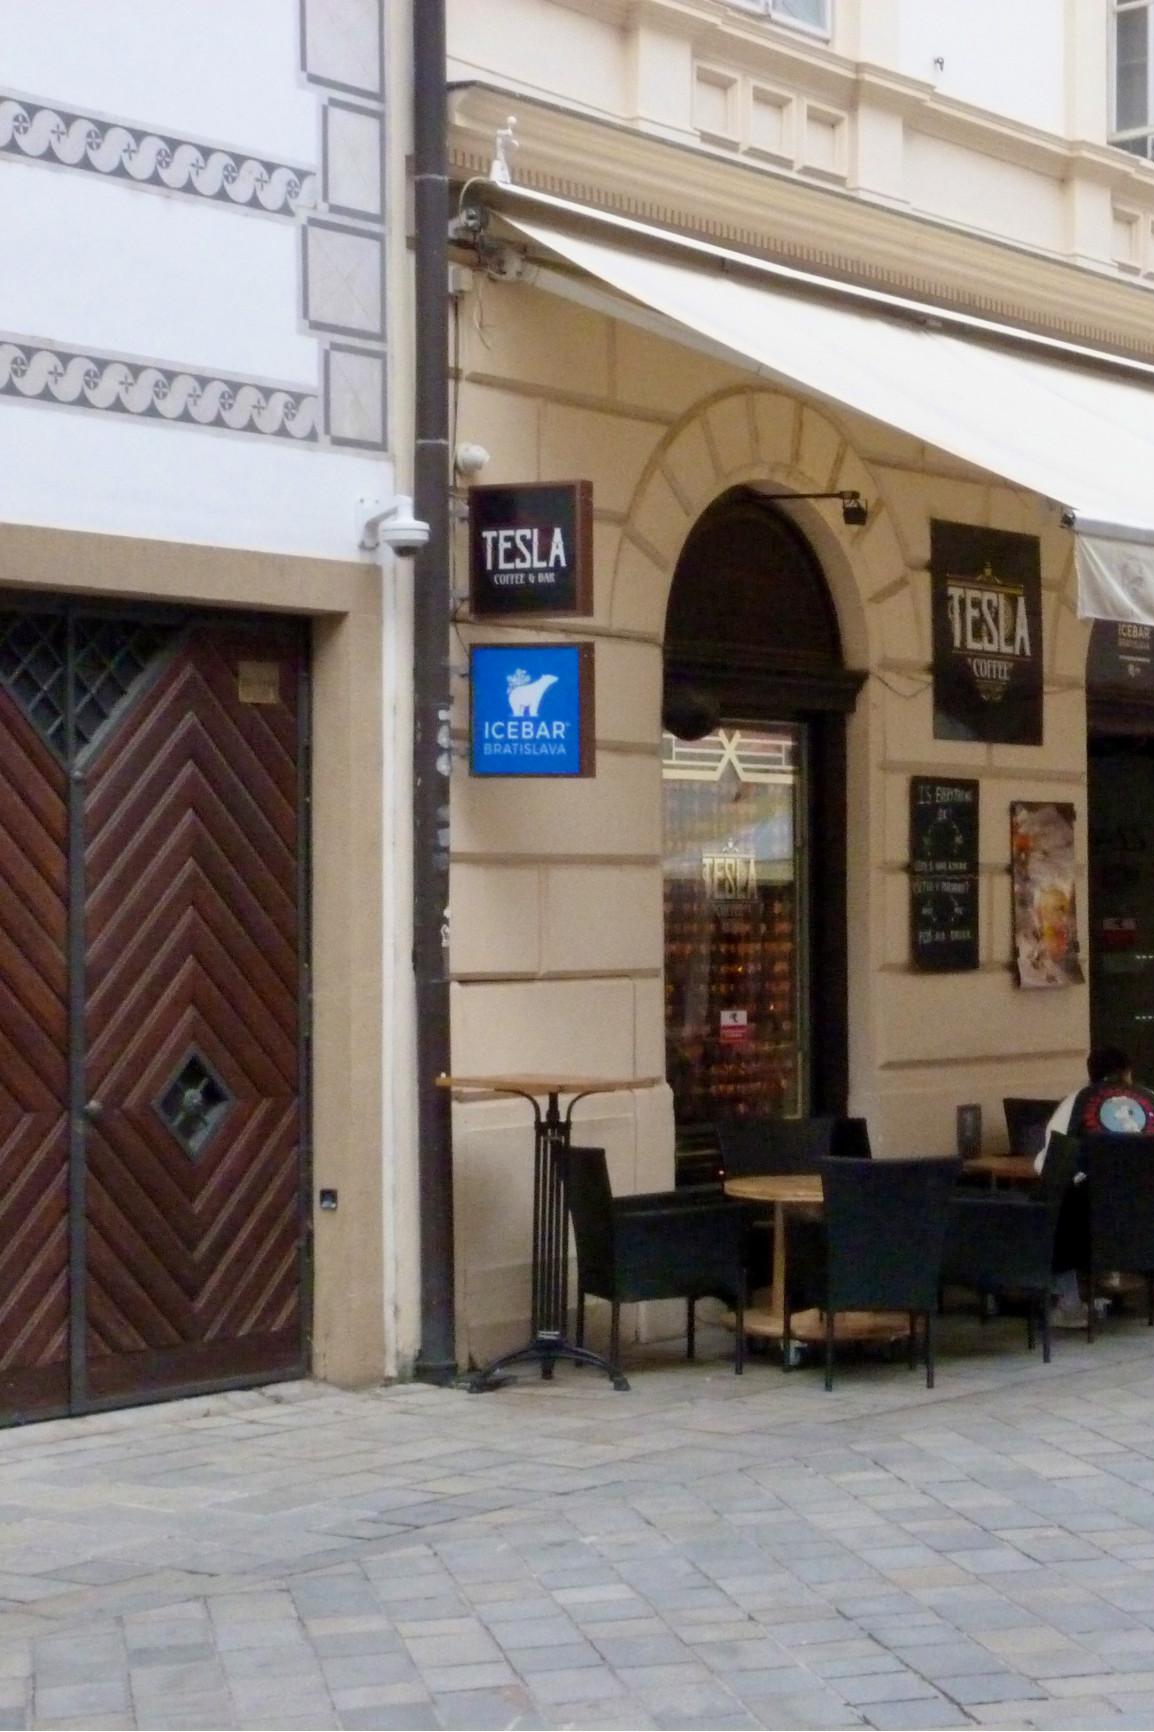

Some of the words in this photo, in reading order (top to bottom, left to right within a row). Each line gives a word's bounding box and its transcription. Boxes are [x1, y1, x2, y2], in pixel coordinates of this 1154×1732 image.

[481, 527, 567, 571] TESLA
[494, 573, 526, 585] COFFEE
[537, 572, 556, 583] BAR
[947, 586, 1031, 656] TESLA
[972, 657, 1011, 681] COFFEE
[484, 721, 566, 739] ICEBAR
[483, 742, 567, 755] BRATISLAVA
[702, 857, 758, 899] TESLA
